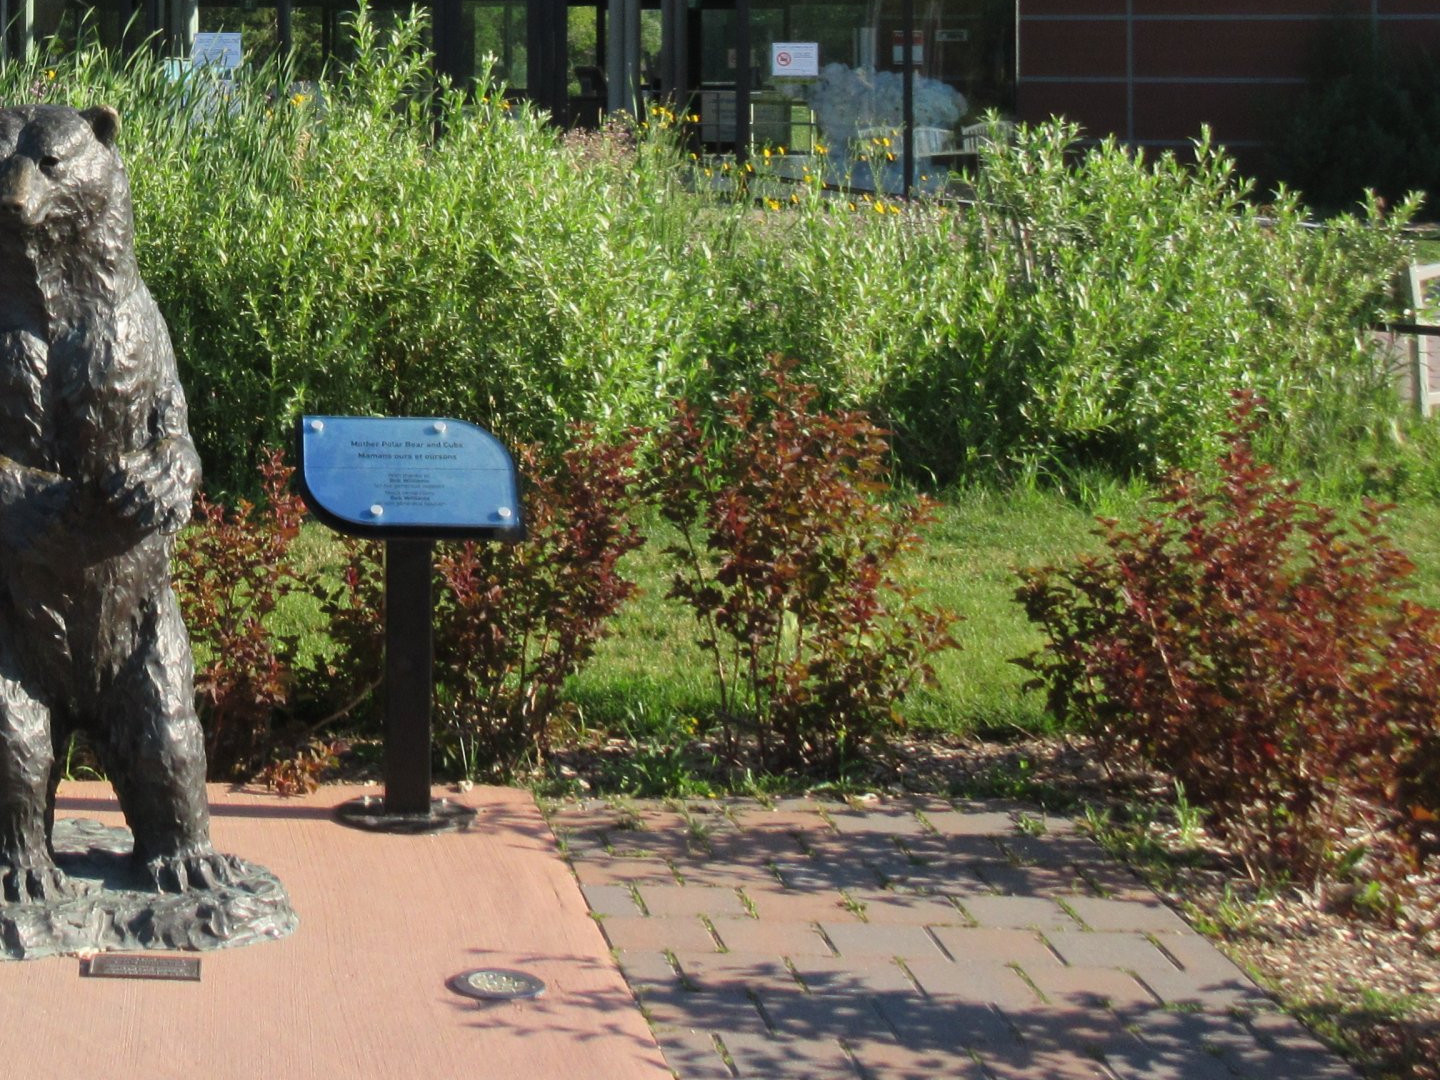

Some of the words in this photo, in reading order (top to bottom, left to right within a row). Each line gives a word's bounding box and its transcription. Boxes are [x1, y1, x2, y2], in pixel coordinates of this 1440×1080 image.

[350, 440, 379, 448] Mother
[381, 440, 402, 448] Polar
[405, 440, 424, 448] Bear
[426, 441, 441, 449] and
[443, 441, 464, 449] Cubs
